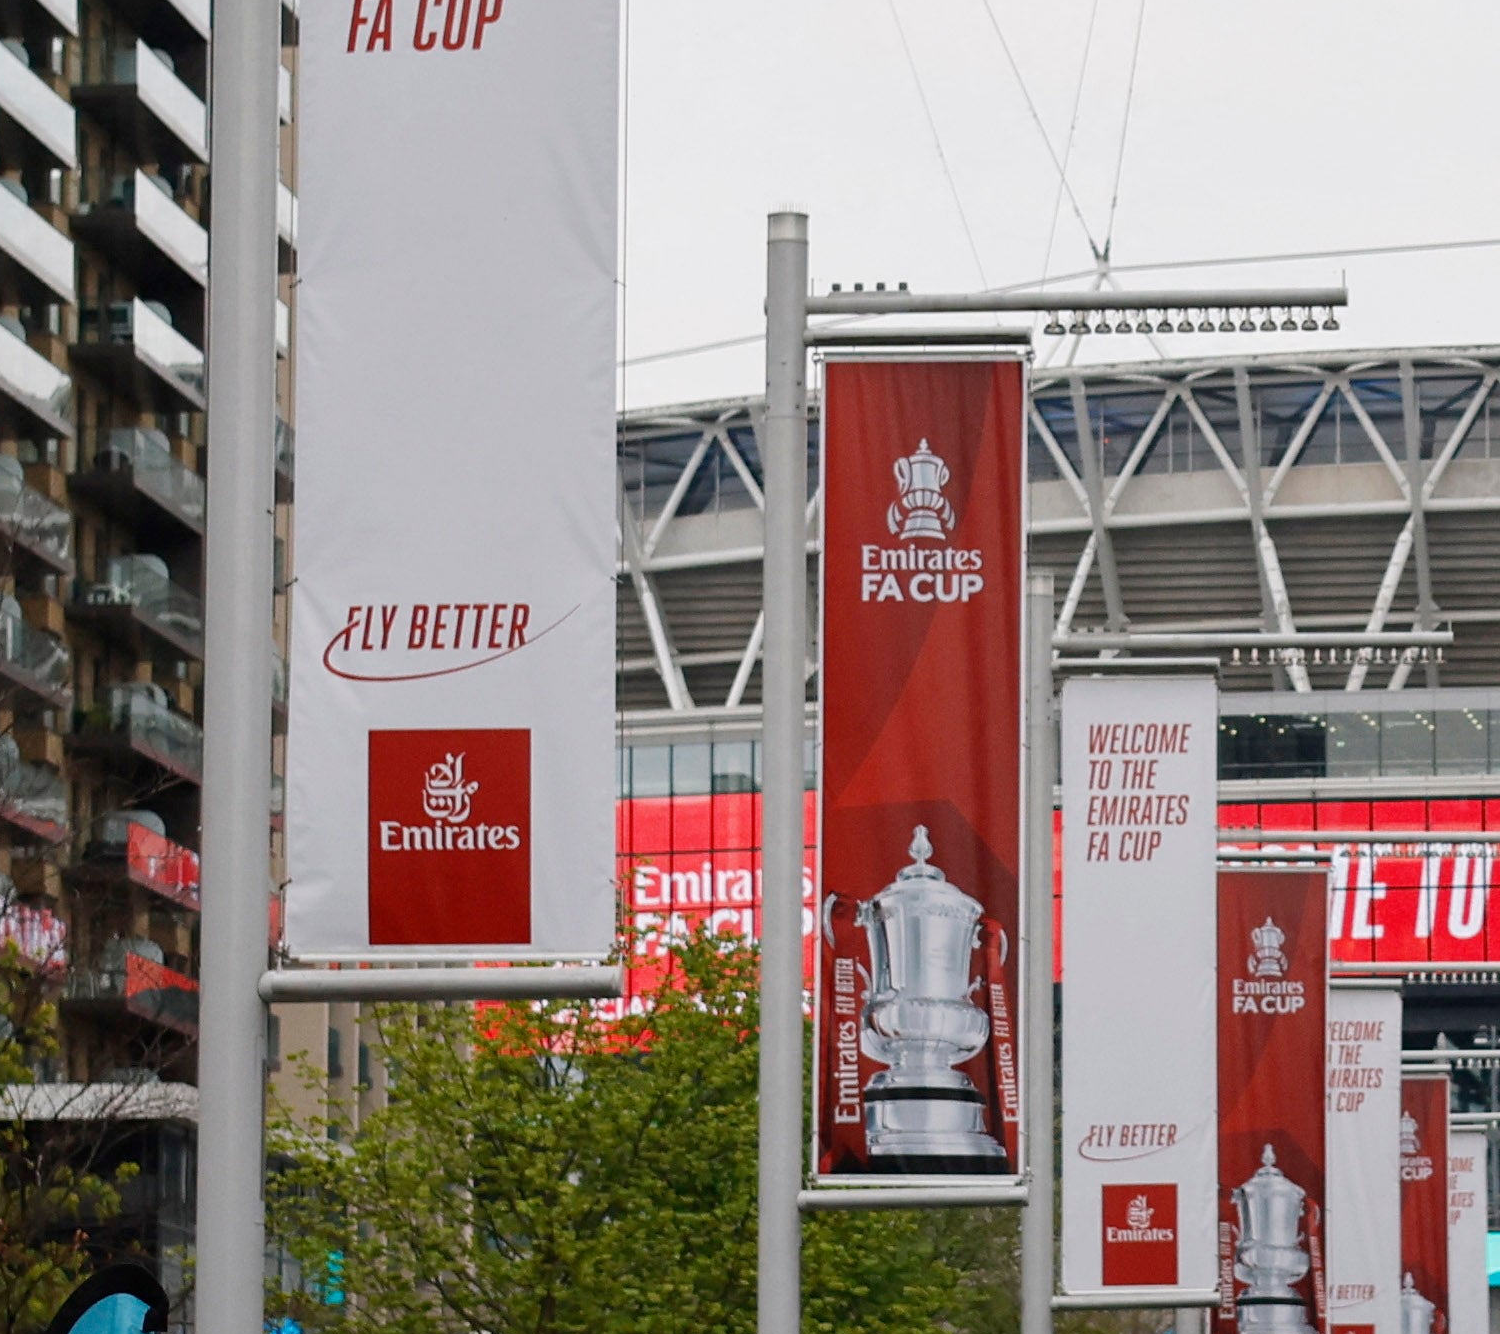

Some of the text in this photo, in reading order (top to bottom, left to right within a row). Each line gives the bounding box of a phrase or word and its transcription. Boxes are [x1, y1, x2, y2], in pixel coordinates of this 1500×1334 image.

[861, 544, 982, 570] Emirates
[861, 573, 984, 602] FA CUP
[342, 604, 530, 651] FLY BETTER
[1088, 723, 1192, 754] WELCOME
[1089, 760, 1159, 790] TO THE
[1087, 795, 1190, 825] EMIRATES
[379, 819, 520, 851] Emirates
[1087, 831, 1162, 862] FA CUP
[1414, 841, 1494, 939] TO
[1232, 979, 1305, 995] Emirates
[835, 993, 856, 1016] FLY
[1232, 996, 1305, 1014] FA CUP
[1328, 1021, 1385, 1041] ELCOME
[1338, 1044, 1363, 1065] THE
[835, 1021, 861, 1124] Emirates
[994, 1043, 1019, 1123] Emirates
[1336, 1092, 1365, 1112] CUP
[1087, 1123, 1178, 1147] FLY BETTER
[1106, 1226, 1174, 1242] Emirates
